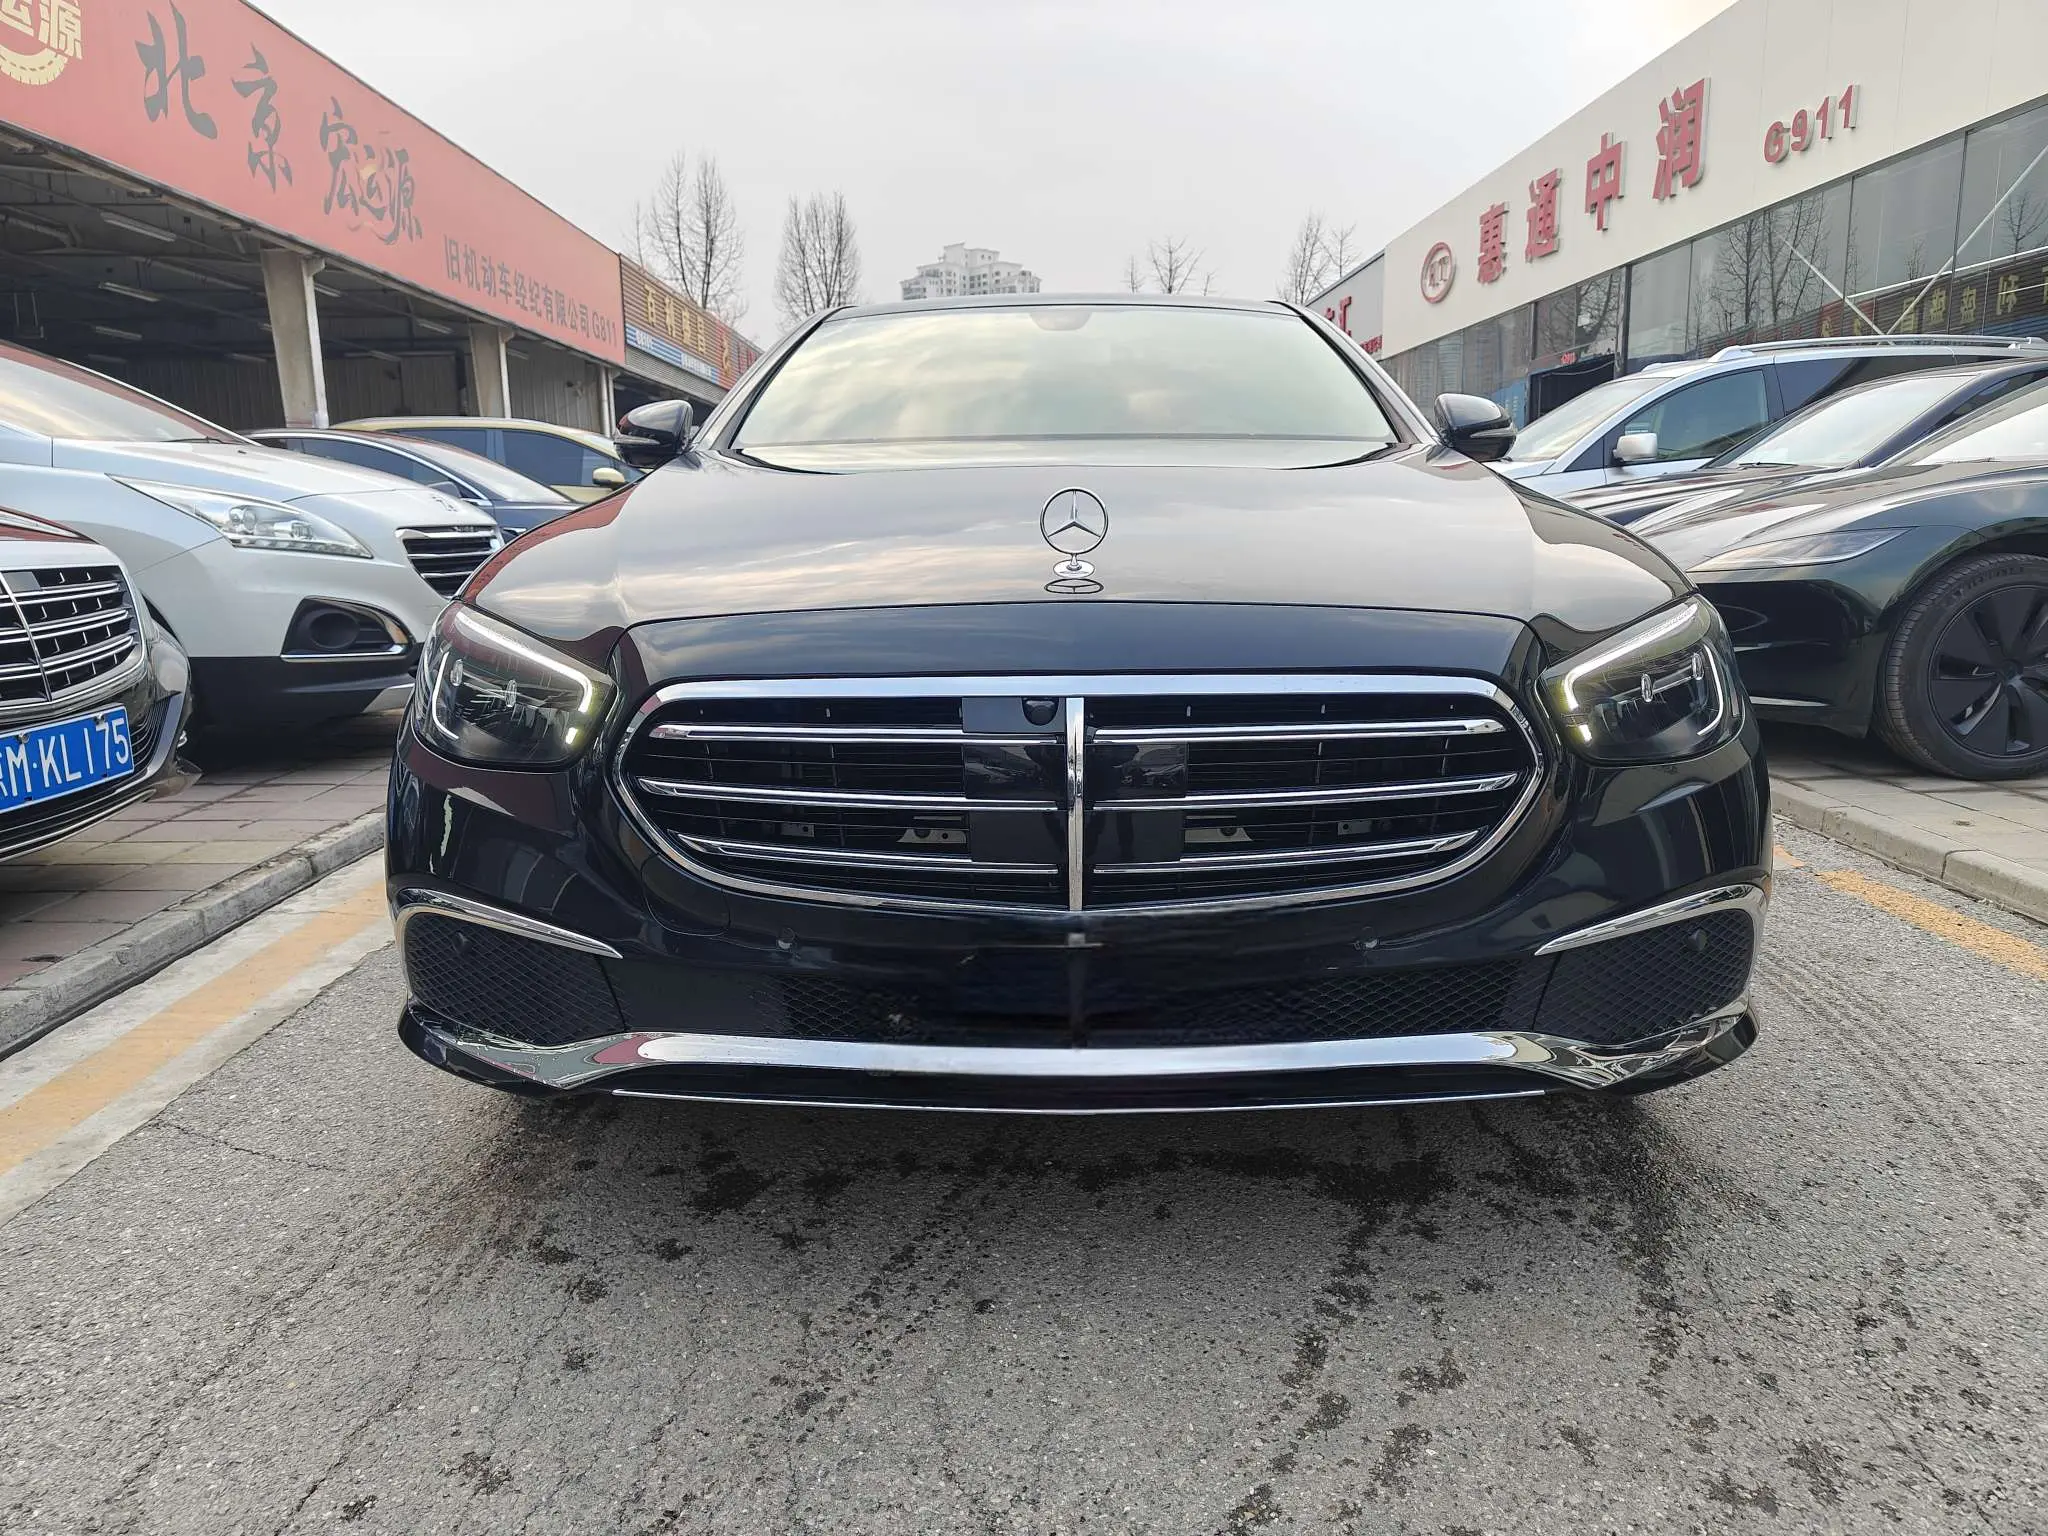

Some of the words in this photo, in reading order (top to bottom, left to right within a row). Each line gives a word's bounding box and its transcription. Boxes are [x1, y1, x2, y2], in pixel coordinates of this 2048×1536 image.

[1477, 77, 1712, 285] 惠通中润
[1763, 84, 1861, 163] G911
[444, 234, 590, 339] 旧机动车经纪有限公司
[592, 312, 617, 347] G811
